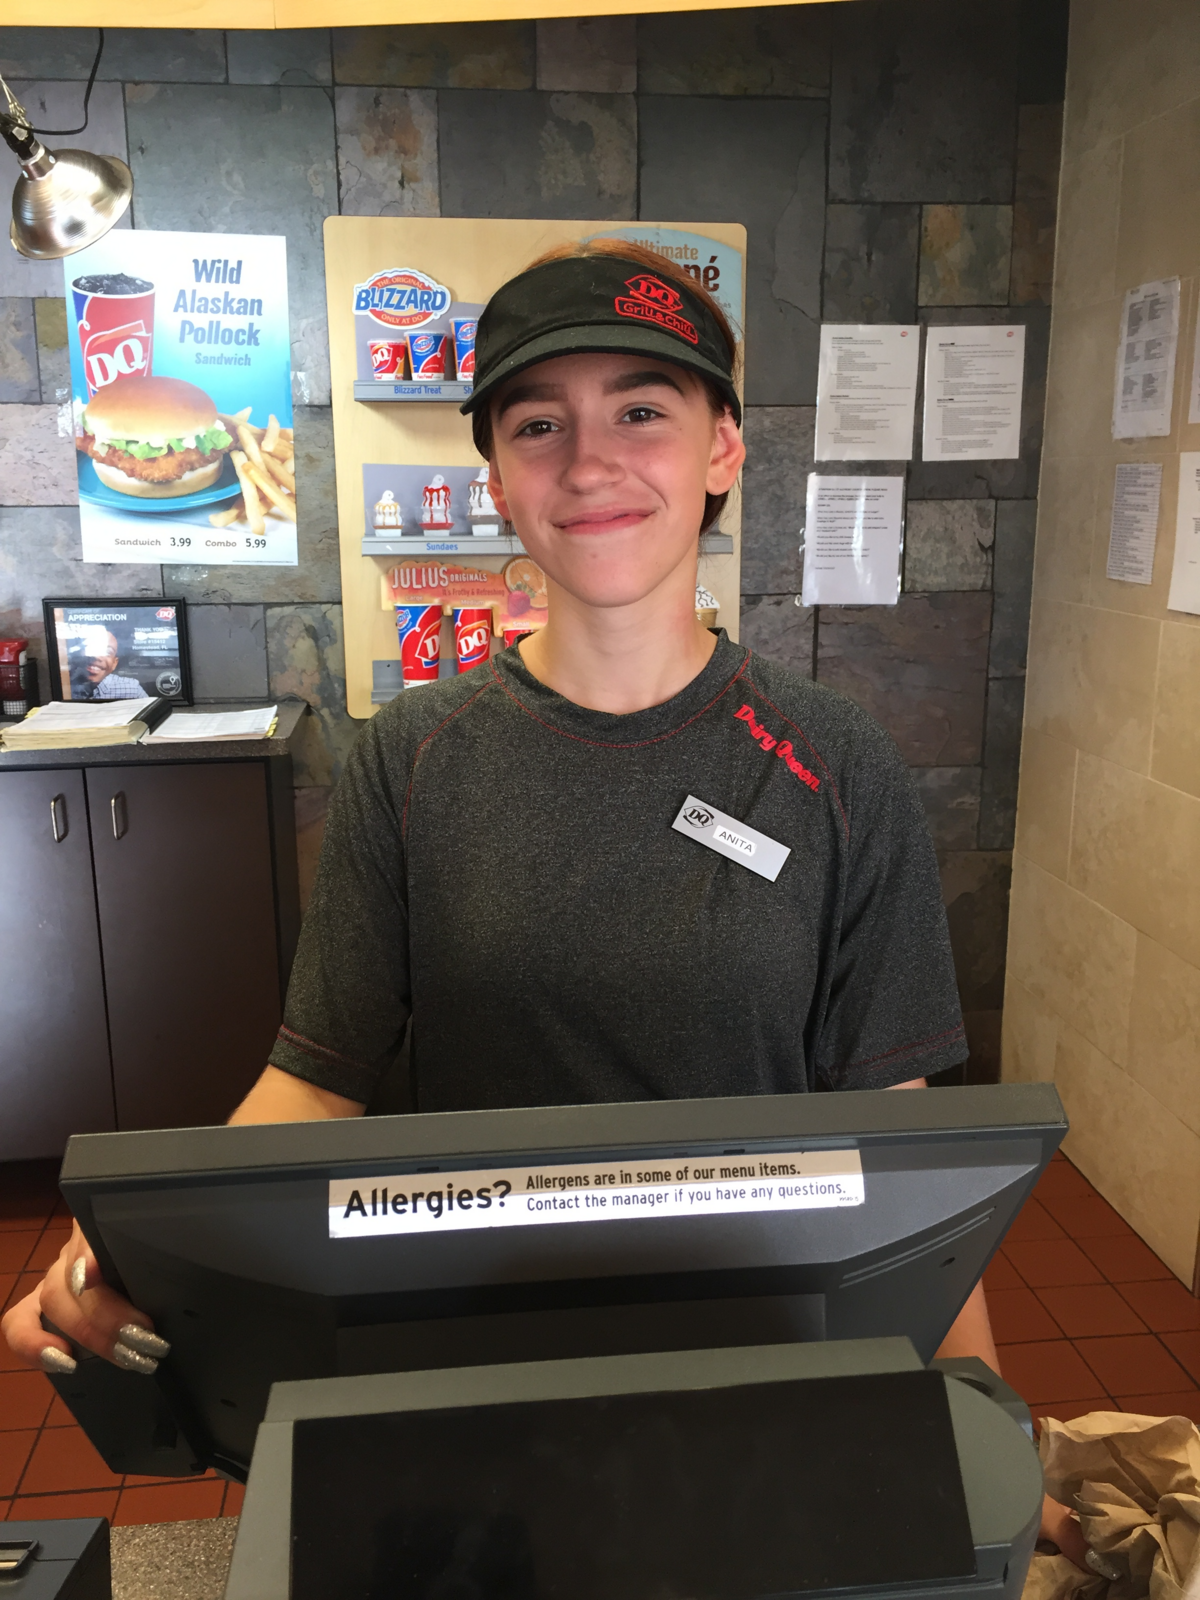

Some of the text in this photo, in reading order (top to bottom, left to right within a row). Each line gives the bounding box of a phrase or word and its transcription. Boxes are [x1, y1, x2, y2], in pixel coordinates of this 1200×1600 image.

[191, 258, 243, 285] Wild
[377, 276, 424, 289] THE ORIGINAL
[638, 279, 675, 306] DQ
[173, 289, 263, 316] Alaskan
[355, 286, 447, 312] BLIZZARD
[381, 313, 399, 324] ONLY
[401, 316, 410, 324] AT
[623, 302, 655, 318] Grill
[179, 320, 261, 347] Pollock
[87, 338, 147, 388] DQ
[195, 352, 252, 367] Sandwich
[372, 348, 390, 368] DQ
[394, 385, 442, 394] Blizzard Treat
[114, 536, 267, 549] Sandwich 3.99 Combo 5.99
[426, 542, 459, 551] Sundaes
[392, 566, 488, 589] JULIUS ORIGINALS
[406, 594, 423, 602] Large
[476, 588, 505, 598] Refreshing
[68, 613, 127, 622] APPRECIATION
[160, 610, 173, 618] DQ
[459, 628, 489, 656] DQ
[688, 808, 710, 826] DQ
[719, 830, 753, 853] ANITA
[526, 1162, 801, 1191] Allergens are in some of our menu items.
[343, 1179, 512, 1219] Allergies?
[526, 1181, 847, 1212] Contact the manager if you have any questions.
